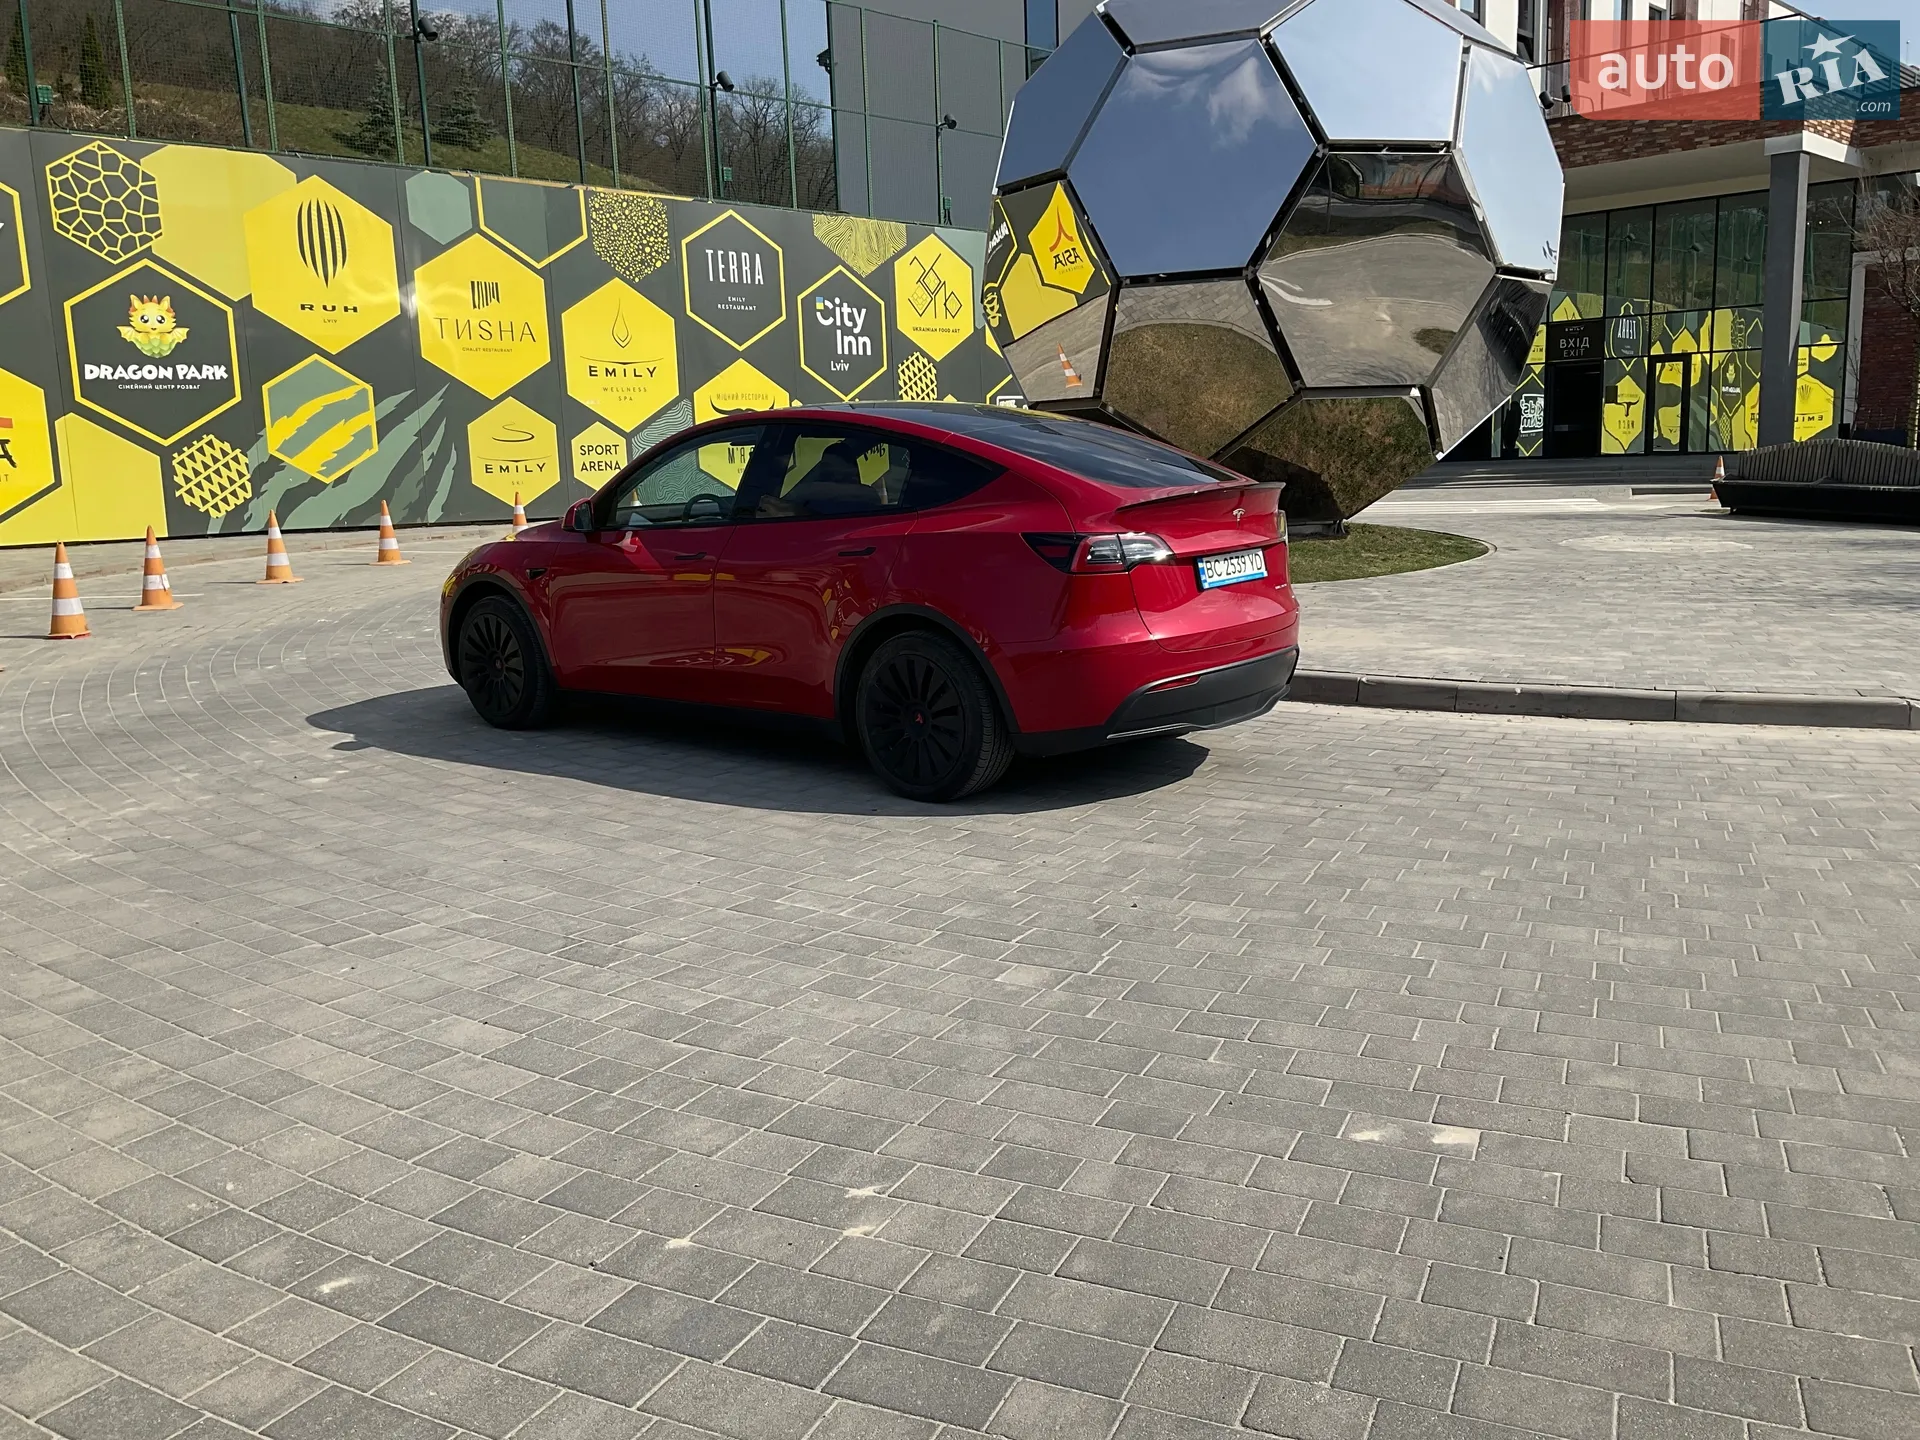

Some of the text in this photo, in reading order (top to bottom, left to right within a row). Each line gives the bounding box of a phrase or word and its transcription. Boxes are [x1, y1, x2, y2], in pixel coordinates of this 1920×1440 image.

[705, 249, 764, 285] TERRA
[300, 303, 358, 313] RUH
[717, 303, 757, 311] RESTAURANT
[815, 296, 867, 334] City
[836, 329, 872, 356] Inn
[1560, 337, 1590, 349] ВХІД
[1563, 348, 1586, 357] EXIT
[588, 365, 657, 378] EMILY
[830, 359, 850, 372] Lviv
[84, 363, 229, 381] DRAGON PARK
[740, 393, 769, 401] РЕСТОРАН
[579, 444, 620, 456] SPORT
[484, 462, 546, 474] EMILY
[580, 460, 622, 472] ARENA
[1205, 553, 1263, 579] BC 2539 YD
